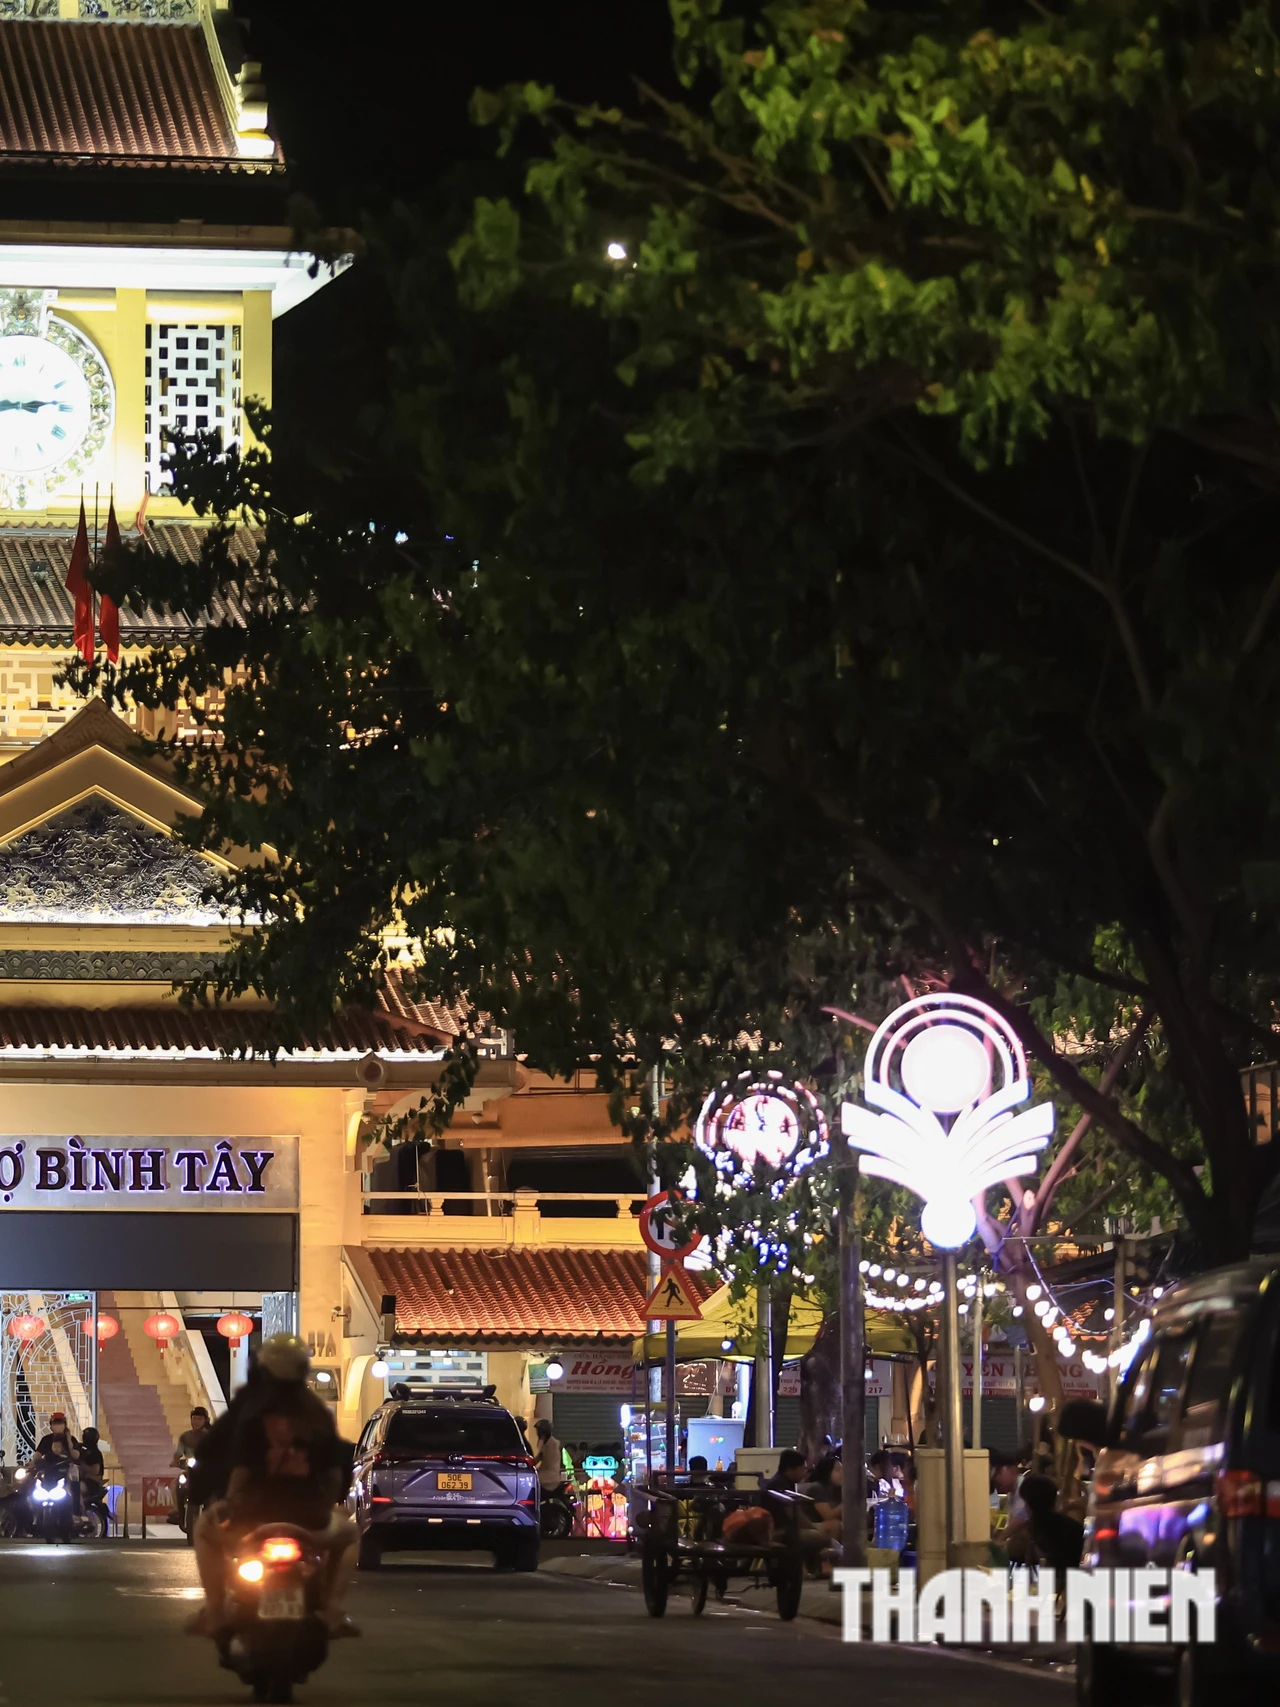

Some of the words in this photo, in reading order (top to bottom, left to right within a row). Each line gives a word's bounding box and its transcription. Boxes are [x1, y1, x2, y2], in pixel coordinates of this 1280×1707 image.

[35, 1136, 167, 1192] BÌNH
[175, 1140, 275, 1193] TÂY
[868, 1386, 883, 1394] 217
[441, 1481, 469, 1489] 062.39
